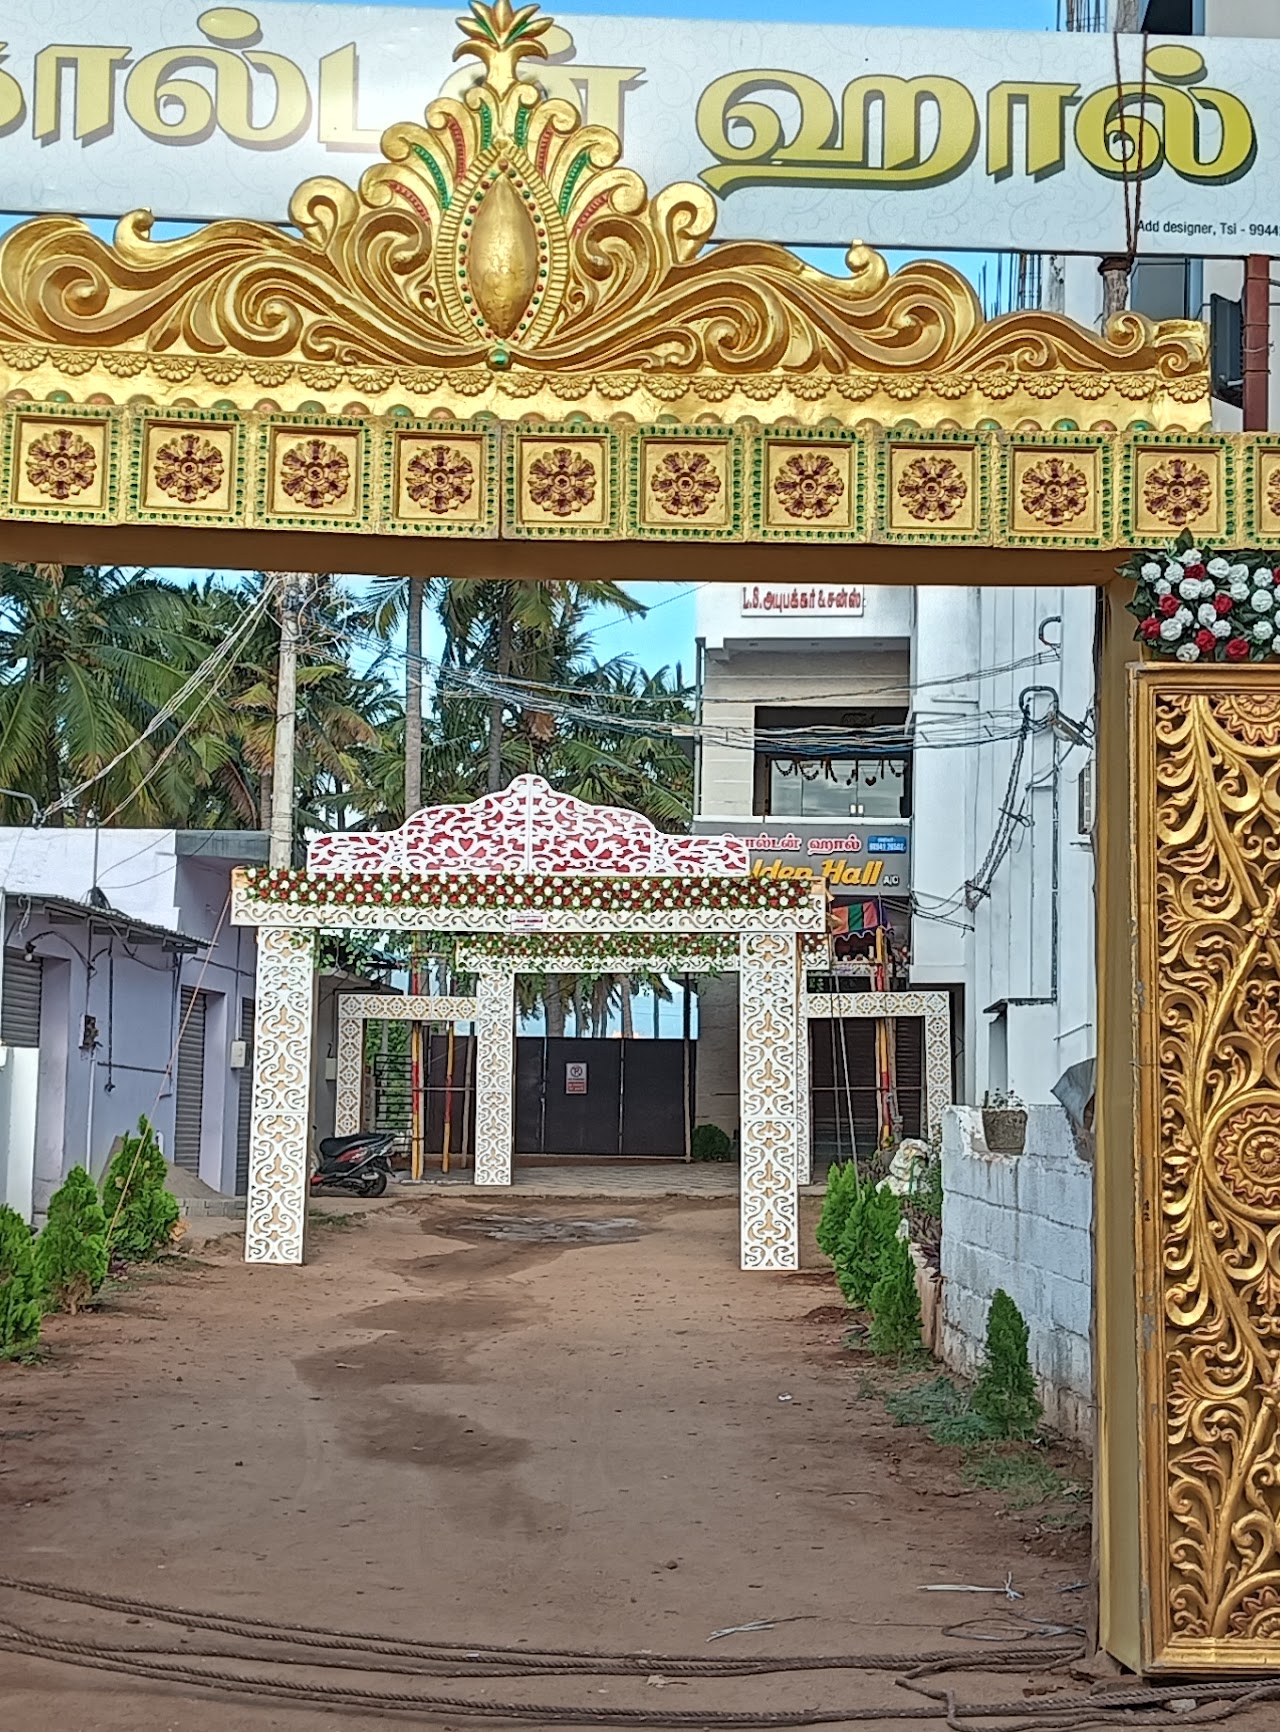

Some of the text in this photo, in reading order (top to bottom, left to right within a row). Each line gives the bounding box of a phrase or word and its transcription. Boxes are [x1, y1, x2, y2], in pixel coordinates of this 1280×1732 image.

[696, 44, 1258, 200] ஹால்
[1137, 220, 1159, 232] Add
[1163, 221, 1217, 236] designer,
[822, 858, 884, 885] Hall
